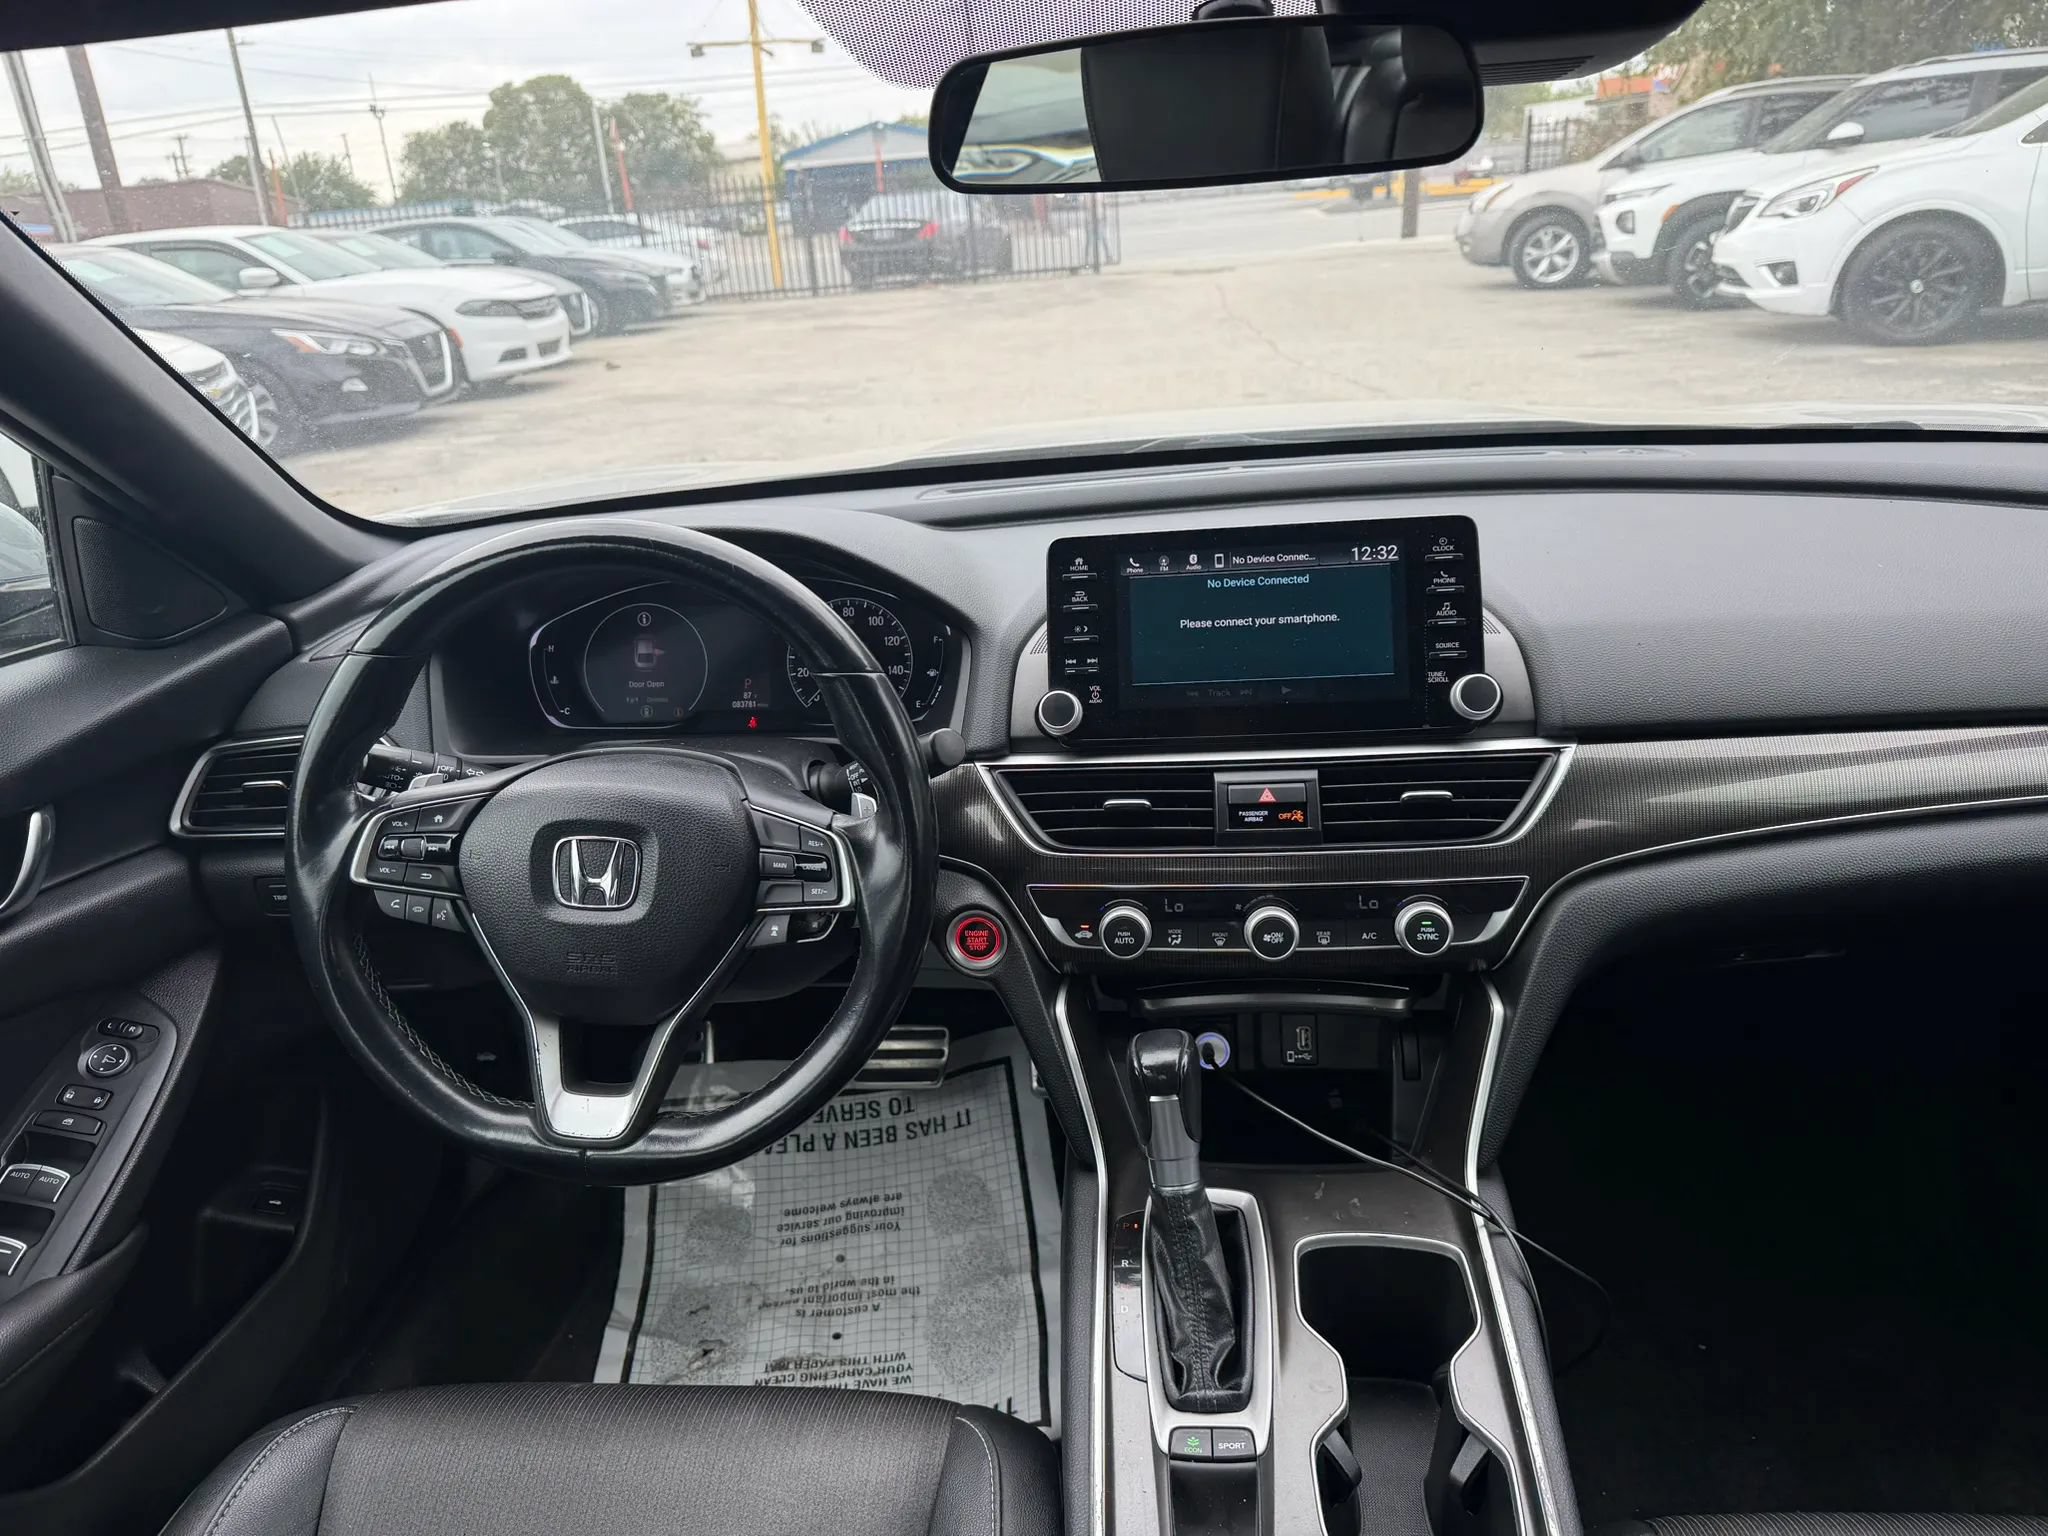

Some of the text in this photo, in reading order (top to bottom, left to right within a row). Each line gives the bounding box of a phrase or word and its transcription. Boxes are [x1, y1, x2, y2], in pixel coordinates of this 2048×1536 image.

[1232, 556, 1245, 564] No
[1246, 554, 1276, 564] Device
[1351, 545, 1399, 561] 12:32
[1207, 574, 1310, 588] No Device Connected
[842, 607, 855, 617] 80
[868, 616, 884, 626] 100
[1180, 613, 1340, 629] Please connect your smartphone.
[884, 636, 900, 646] 120
[548, 645, 555, 653] H
[797, 667, 809, 678] 20
[888, 665, 904, 675] 140
[744, 678, 751, 689] P
[564, 707, 570, 715] C
[1278, 812, 1292, 820] OFF
[1164, 898, 1184, 913] Lo
[1359, 895, 1379, 909] Lo
[1114, 936, 1135, 945] AUTO
[1362, 932, 1377, 940] A/C
[1417, 933, 1439, 941] SYNC
[889, 1096, 915, 1116] TO
[954, 1108, 971, 1129] IT
[906, 1115, 946, 1140] HAS
[823, 1133, 836, 1151] A
[844, 1125, 897, 1148] BEEN
[10, 1171, 30, 1179] AUTO
[39, 1176, 60, 1184] AUTO
[840, 1193, 879, 1208] always
[784, 1202, 837, 1217] welcome
[777, 1206, 905, 1232] improving our service
[780, 1221, 901, 1247] Your suggestions for
[785, 1275, 895, 1296] in the world to us.
[901, 1286, 921, 1296] the
[803, 1291, 862, 1306] important
[867, 1288, 897, 1300] most
[796, 1302, 880, 1318] A customer is
[1120, 1305, 1128, 1313] D
[840, 1354, 868, 1366] THIS
[873, 1351, 906, 1364] WITH
[794, 1358, 835, 1370] PAPER
[878, 1362, 913, 1374] YOUR
[800, 1368, 873, 1382] CARPETING
[892, 1374, 912, 1385] WE
[854, 1376, 888, 1389] HAVE
